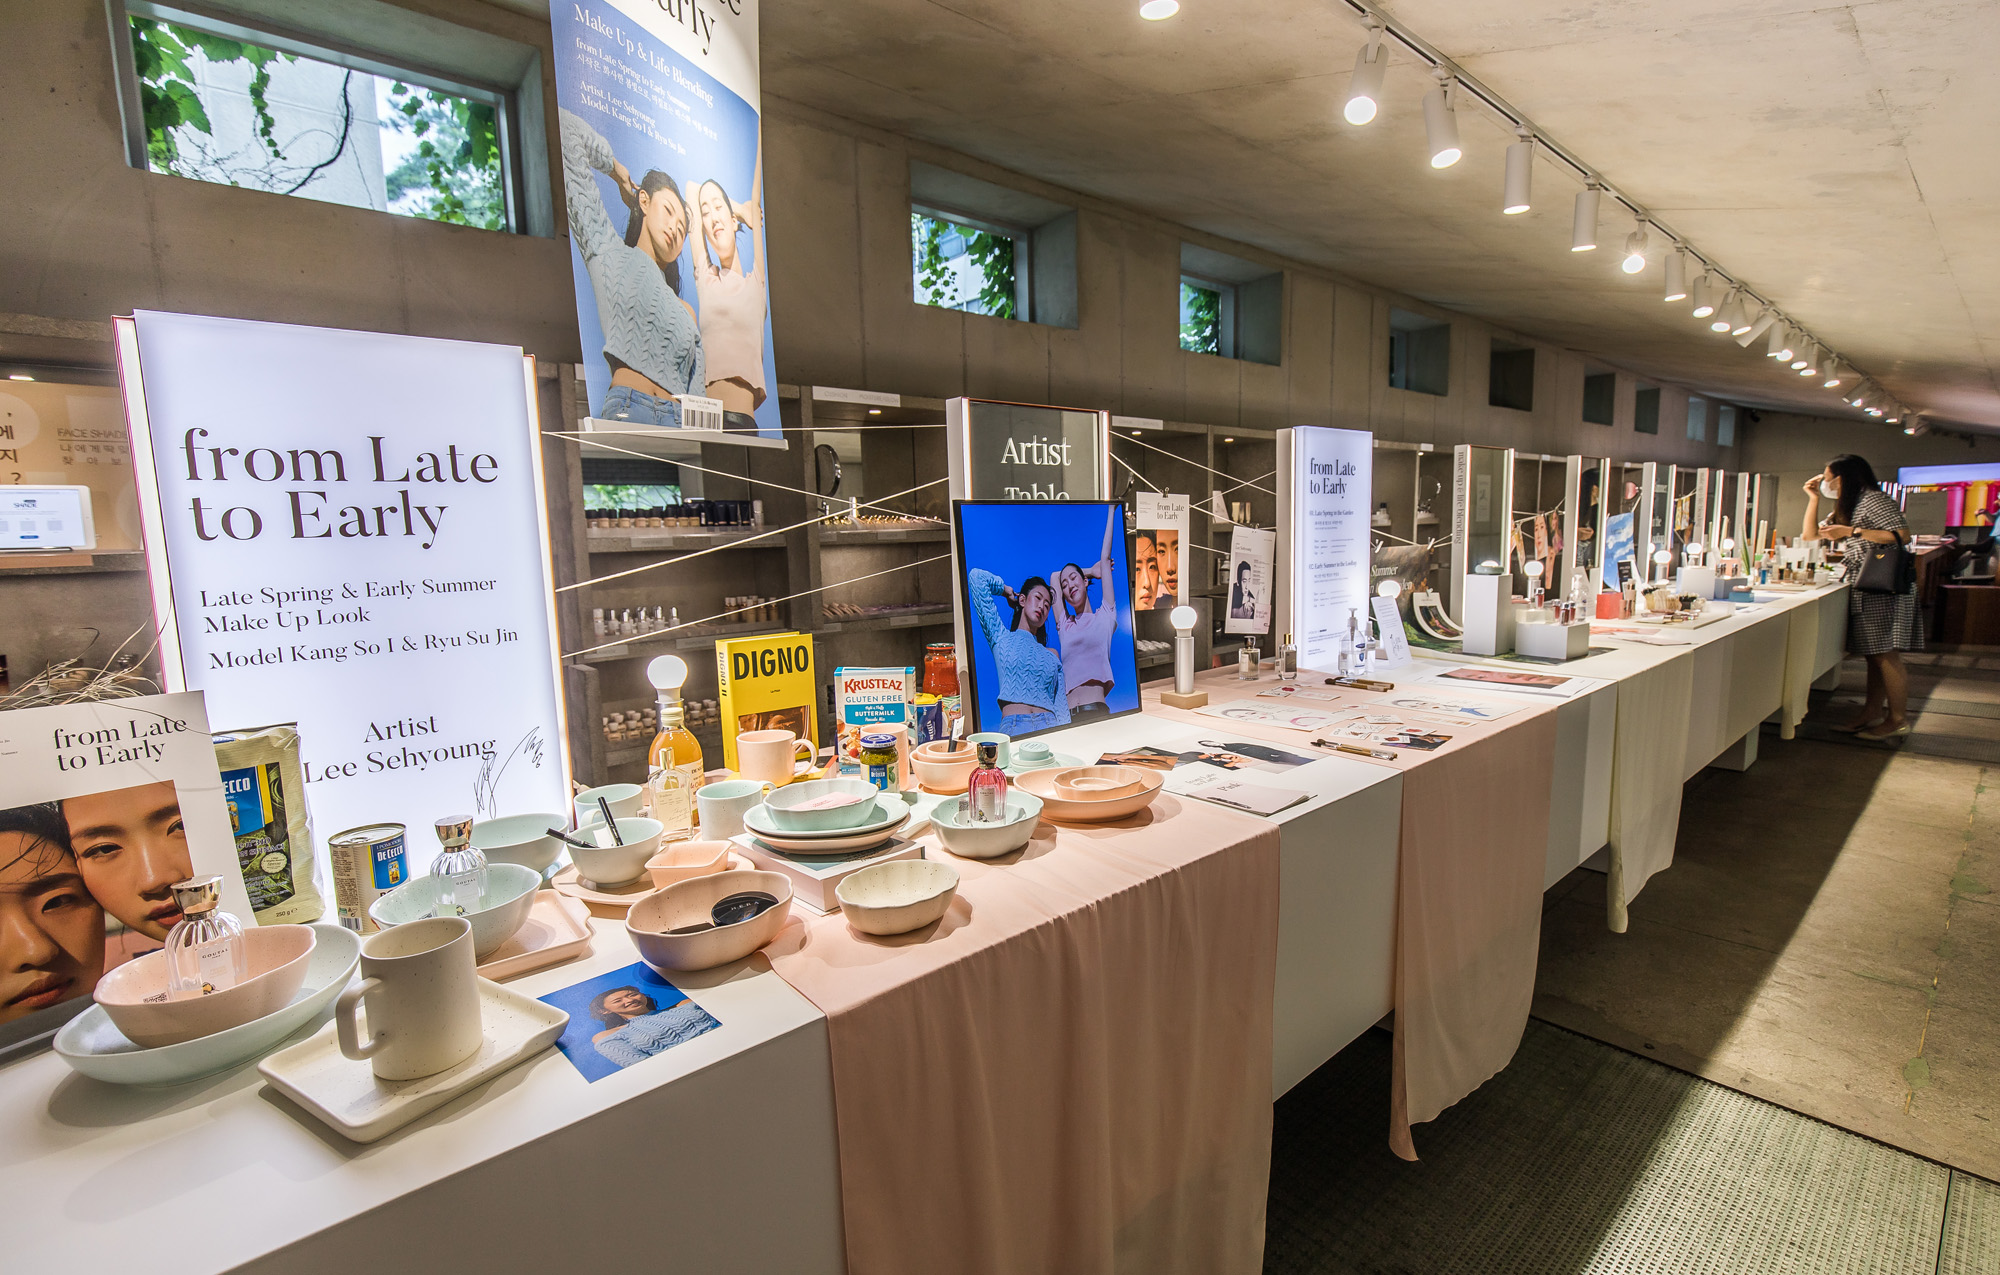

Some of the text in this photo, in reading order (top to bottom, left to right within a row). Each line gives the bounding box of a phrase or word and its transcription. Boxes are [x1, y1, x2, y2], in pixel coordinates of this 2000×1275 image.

[651, 0, 716, 55] arly
[575, 4, 714, 108] Make Up & Life Blending
[576, 38, 597, 54] from
[599, 48, 617, 66] Late
[617, 57, 641, 83] Spring
[576, 53, 601, 72] 시작은
[580, 80, 656, 129] Artist. Lee Sehyoung
[581, 93, 611, 115] Model.
[612, 106, 632, 127] Kang
[632, 118, 642, 132] So
[57, 427, 88, 439] FACE
[180, 428, 498, 483] from Late
[1000, 435, 1072, 466] Artist
[1457, 451, 1465, 471] make
[1310, 457, 1356, 476] from Late
[1456, 475, 1463, 486] up
[1310, 477, 1347, 499] to Early
[188, 490, 447, 549] to Early
[1157, 502, 1171, 511] from
[1171, 503, 1185, 512] Late
[1157, 512, 1179, 521] to Early
[1454, 507, 1464, 544] blending
[1371, 564, 1398, 576] Summer
[200, 576, 497, 608] Late Spring & Early Summer
[203, 606, 371, 634] Make Up Look
[208, 647, 282, 670] Model
[290, 643, 348, 665] Kang
[354, 639, 381, 656] So
[402, 636, 418, 652] &
[424, 633, 460, 653] Ryu
[466, 630, 490, 646] Su
[495, 627, 519, 645] Jin
[733, 645, 809, 680] DIGNO
[721, 689, 728, 697] II
[845, 679, 903, 694] KRUSTEAZ
[845, 694, 903, 703] GLUTEN FREE
[53, 717, 187, 749] from Late
[364, 715, 439, 743] Artist
[57, 739, 166, 771] to Early
[304, 739, 496, 784] Lee Sehyoung
[388, 845, 404, 858] CECCO
[731, 901, 760, 910] HERA
[201, 949, 229, 959] GOUTAL
